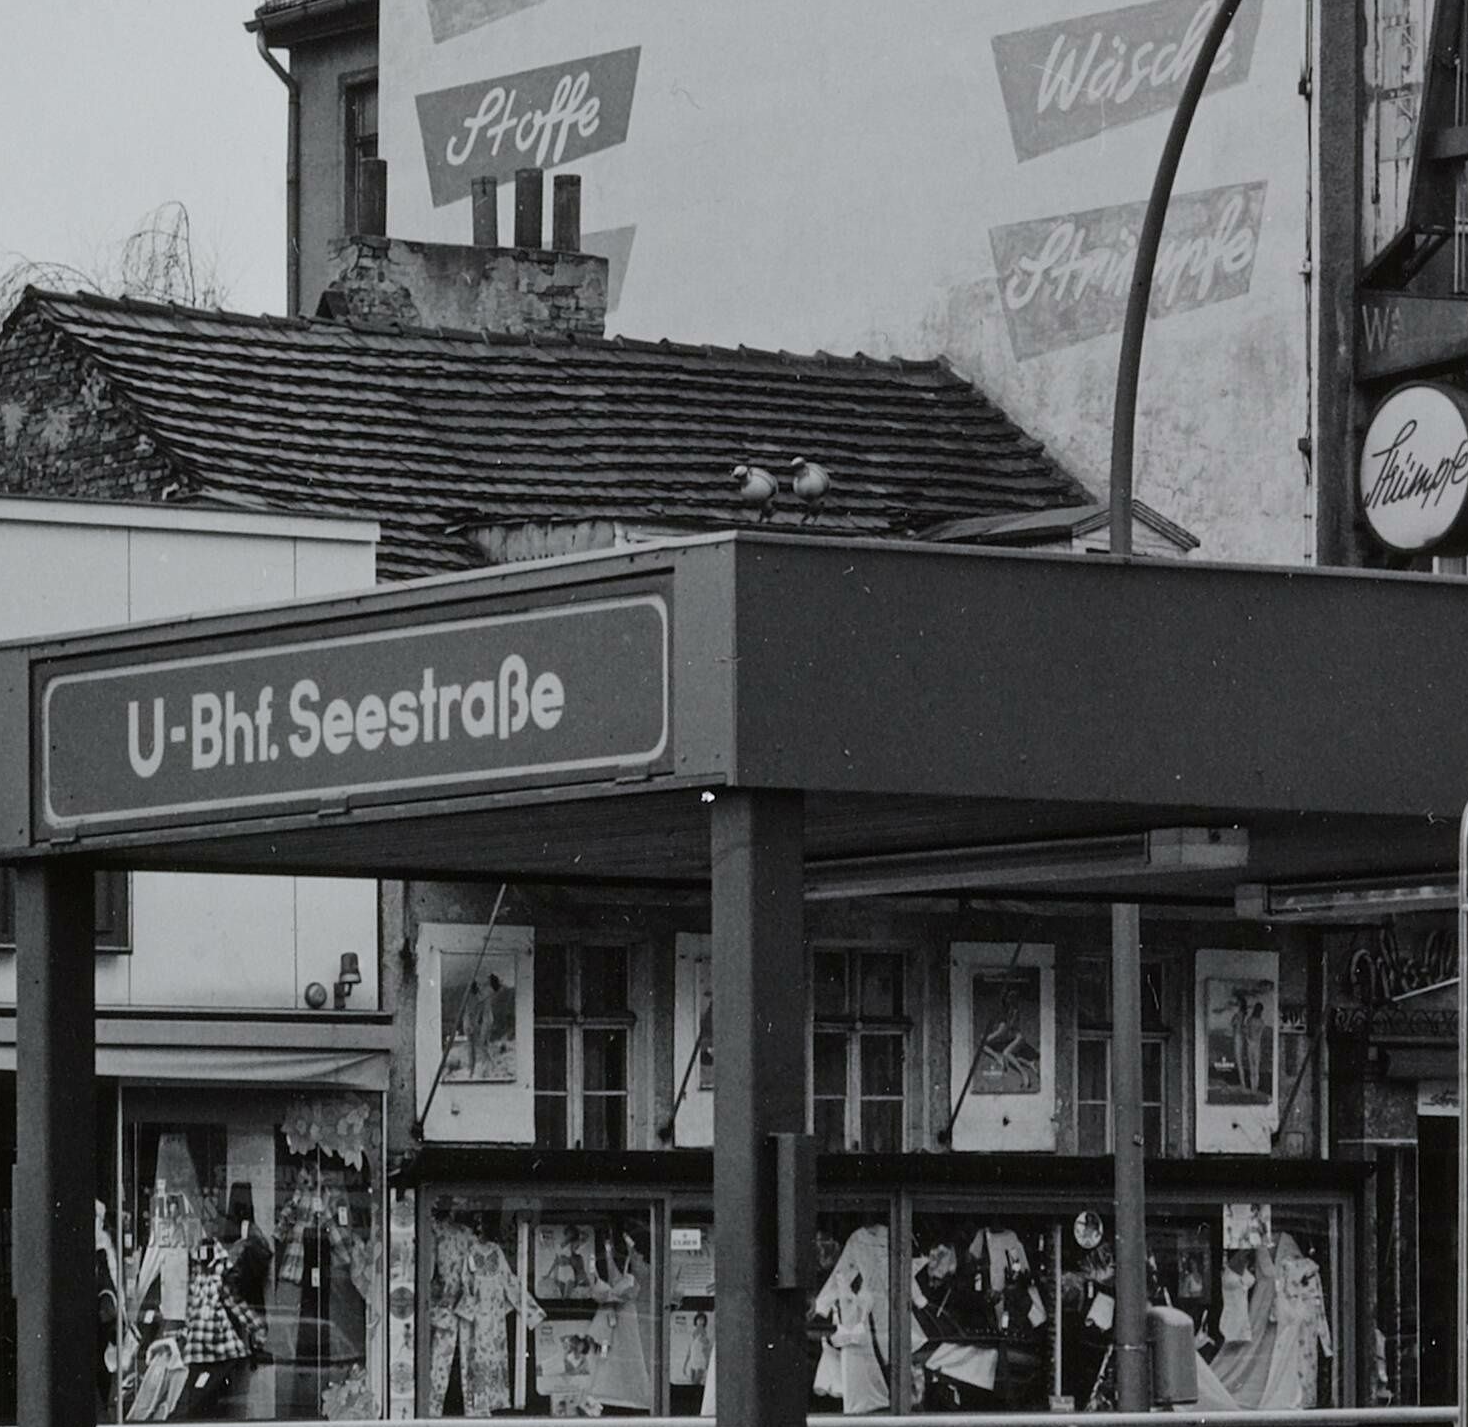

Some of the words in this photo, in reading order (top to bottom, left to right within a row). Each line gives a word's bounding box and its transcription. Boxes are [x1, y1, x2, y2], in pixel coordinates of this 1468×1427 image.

[446, 71, 601, 167] Stoffe
[127, 686, 280, 779] U-Bhf.
[288, 653, 566, 759] Seestraße
